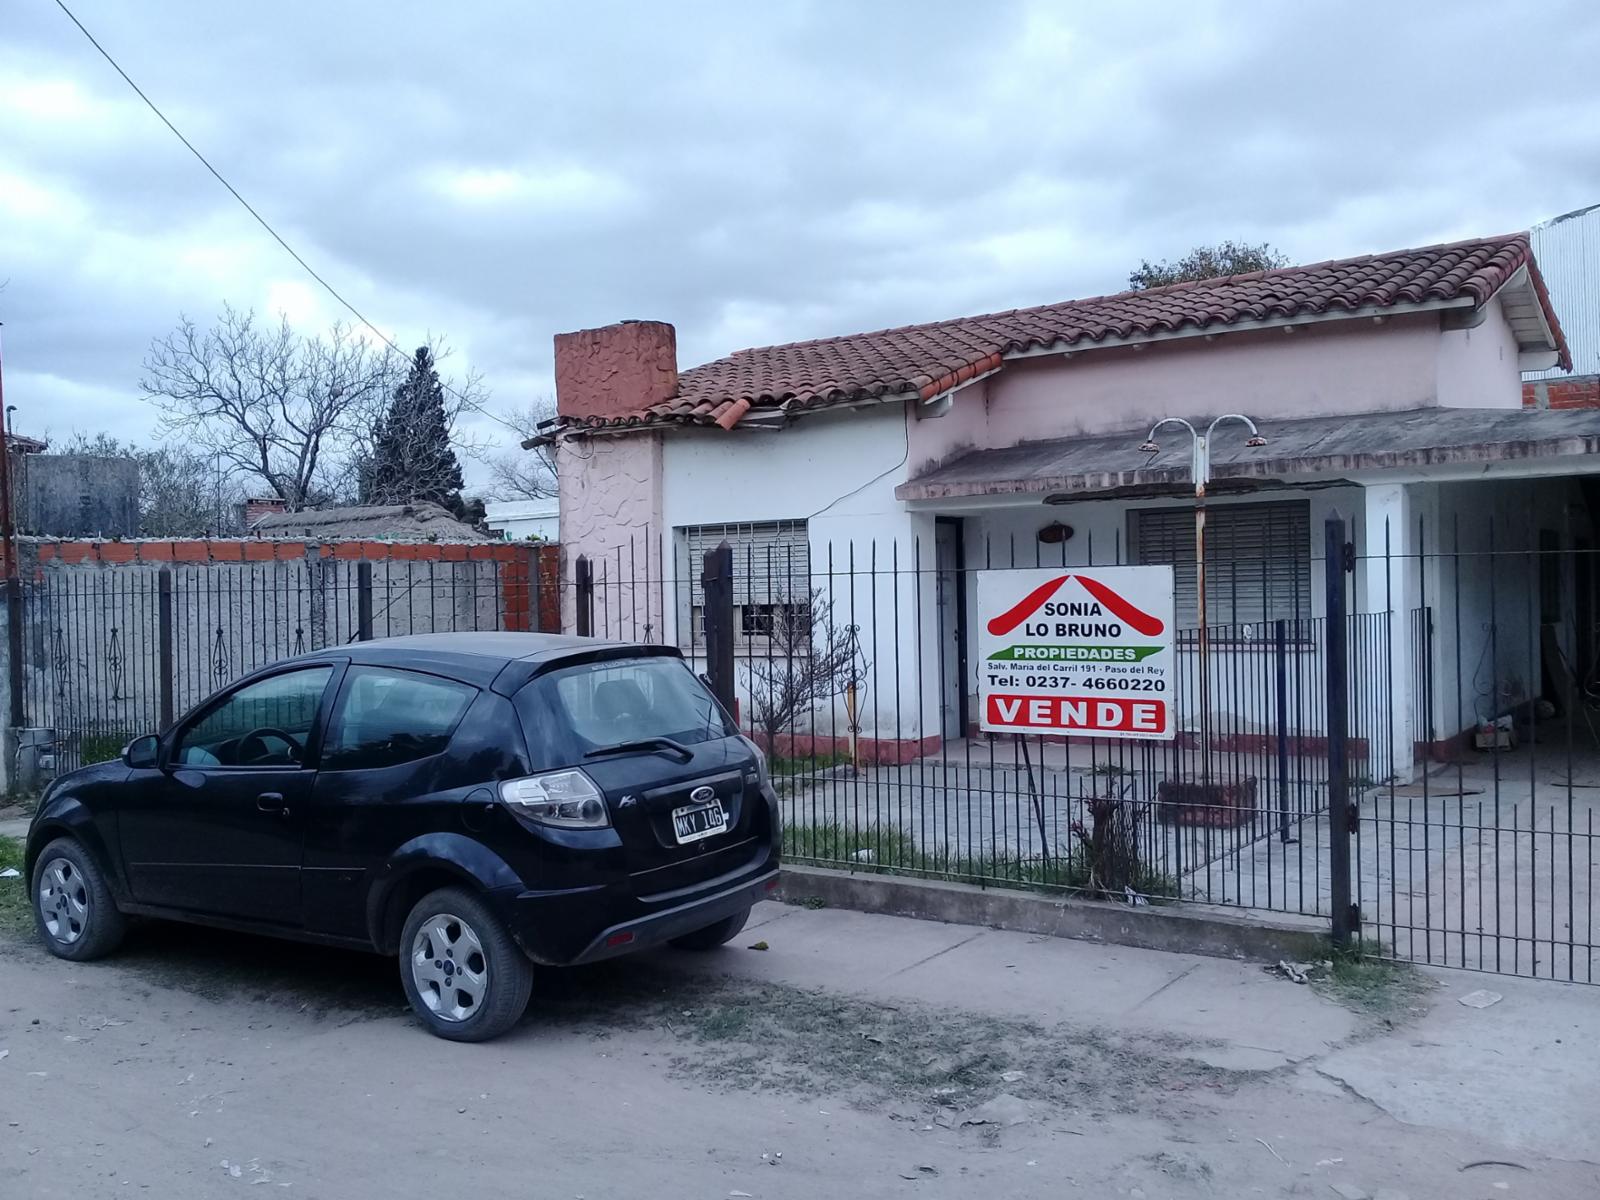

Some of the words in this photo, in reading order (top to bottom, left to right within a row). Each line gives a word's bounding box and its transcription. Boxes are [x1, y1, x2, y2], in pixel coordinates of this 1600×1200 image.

[1044, 602, 1102, 617] SONIA
[1025, 623, 1049, 637] LO
[1055, 623, 1122, 638] BRUNO
[1013, 647, 1136, 660] PROPIEDADES
[988, 662, 1008, 670] Salv.
[1052, 664, 1078, 672] Carril
[1080, 665, 1096, 673] 191
[1105, 665, 1127, 674] Paso
[1130, 666, 1144, 674] del
[1147, 666, 1165, 676] Rey
[987, 674, 1020, 687] Tel:
[1082, 677, 1165, 692] 4660220
[994, 698, 1158, 730] VENDE
[676, 813, 697, 836] MKY
[701, 807, 723, 829] 146
